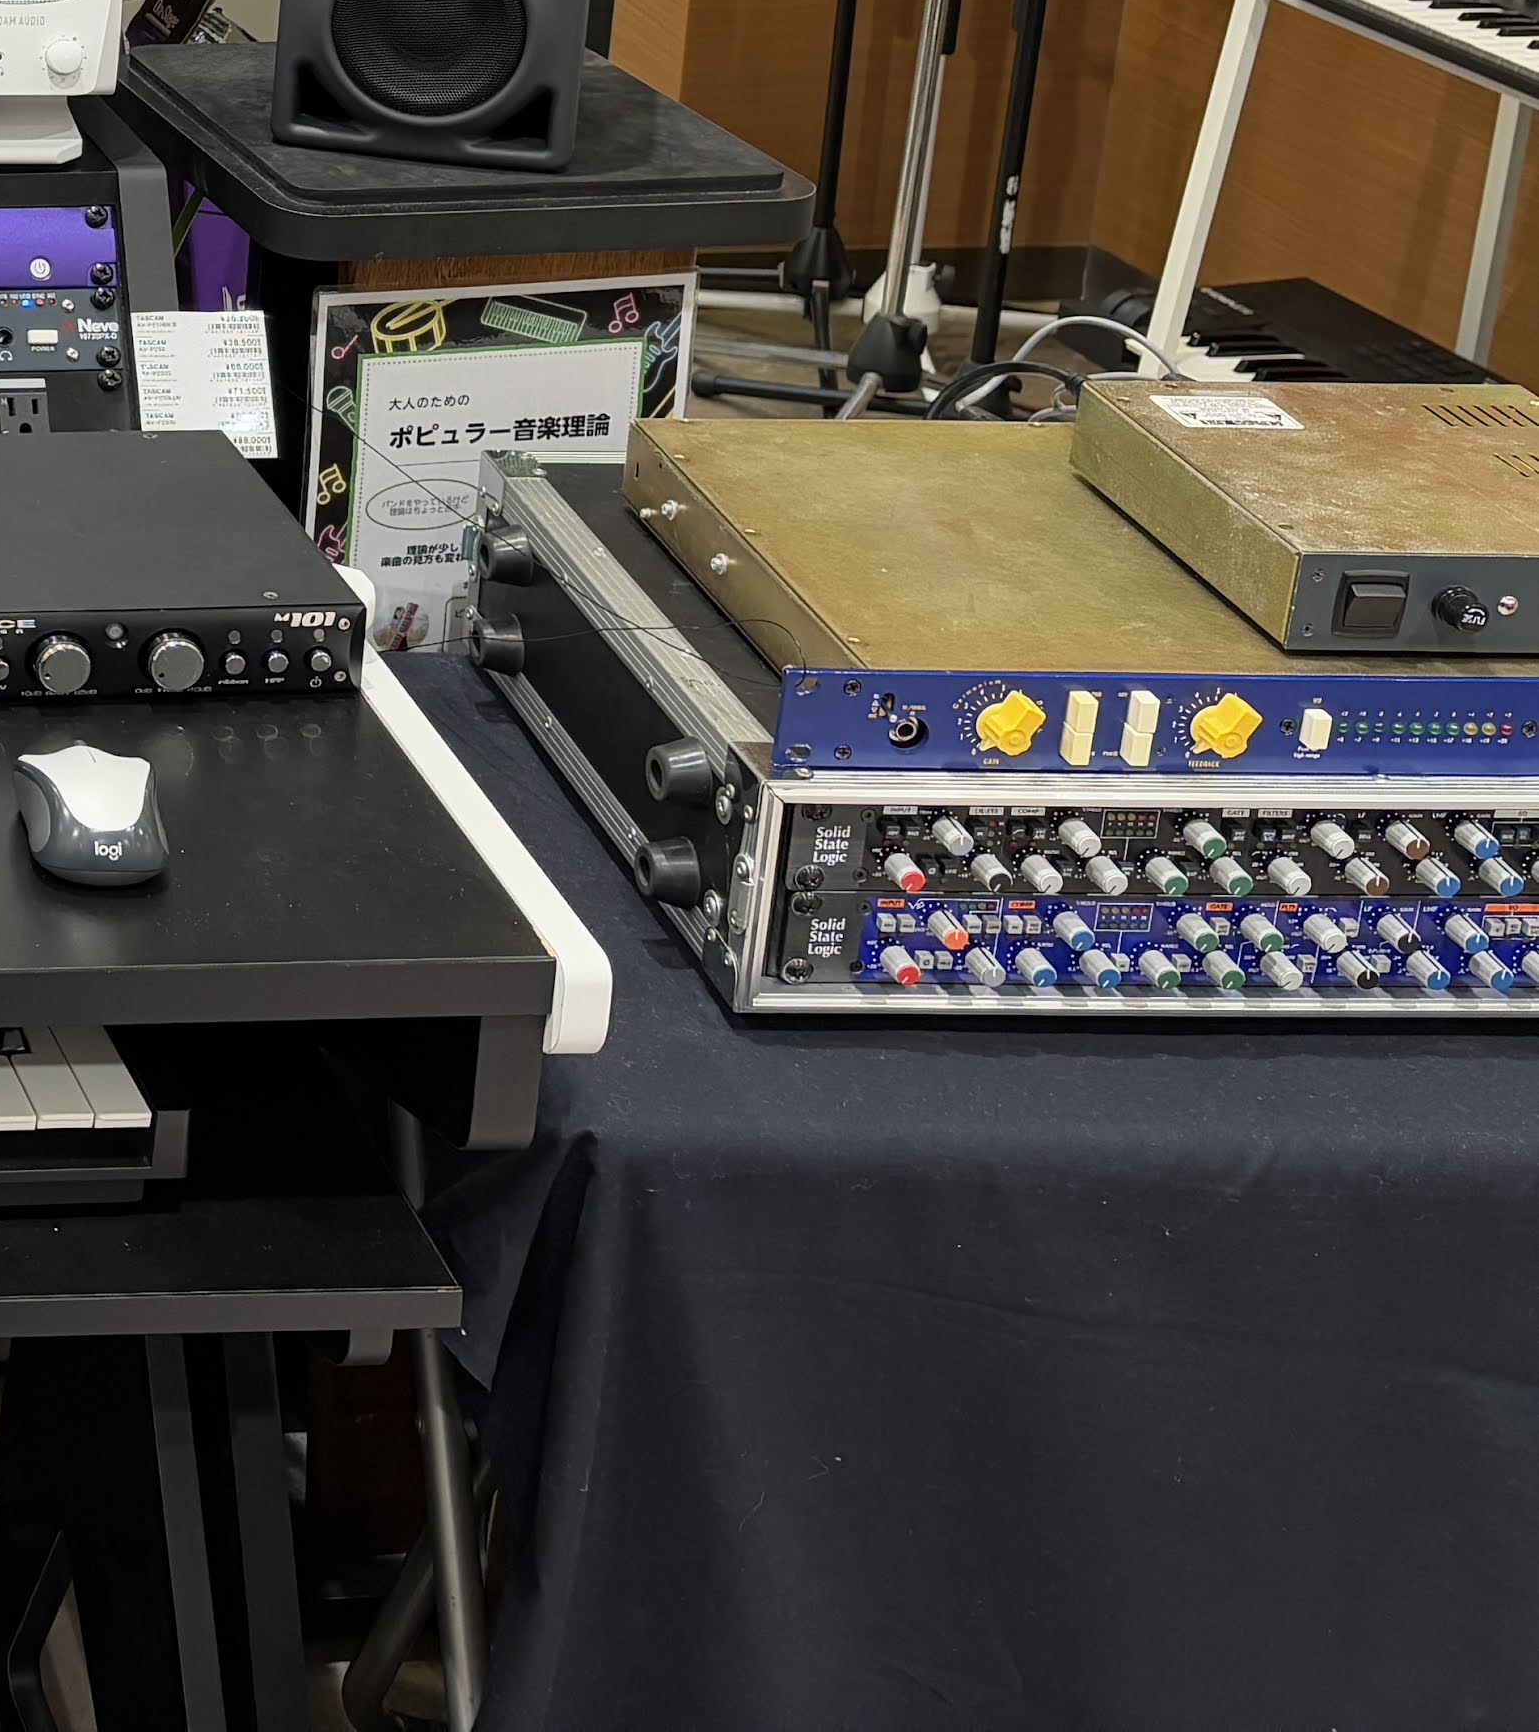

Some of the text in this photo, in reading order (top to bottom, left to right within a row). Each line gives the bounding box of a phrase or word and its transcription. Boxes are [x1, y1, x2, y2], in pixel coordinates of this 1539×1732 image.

[19, 15, 45, 26] AUDIO
[78, 319, 118, 333] Neve
[388, 394, 470, 411] 大人のための
[389, 413, 611, 449] ポピュラー音楽理論
[274, 611, 336, 628] M101
[817, 826, 851, 840] Solid
[94, 840, 122, 861] logi
[815, 838, 850, 851] State
[813, 850, 847, 866] Logic
[811, 919, 846, 933] Solid
[810, 931, 844, 944] State
[807, 942, 841, 958] Logic
